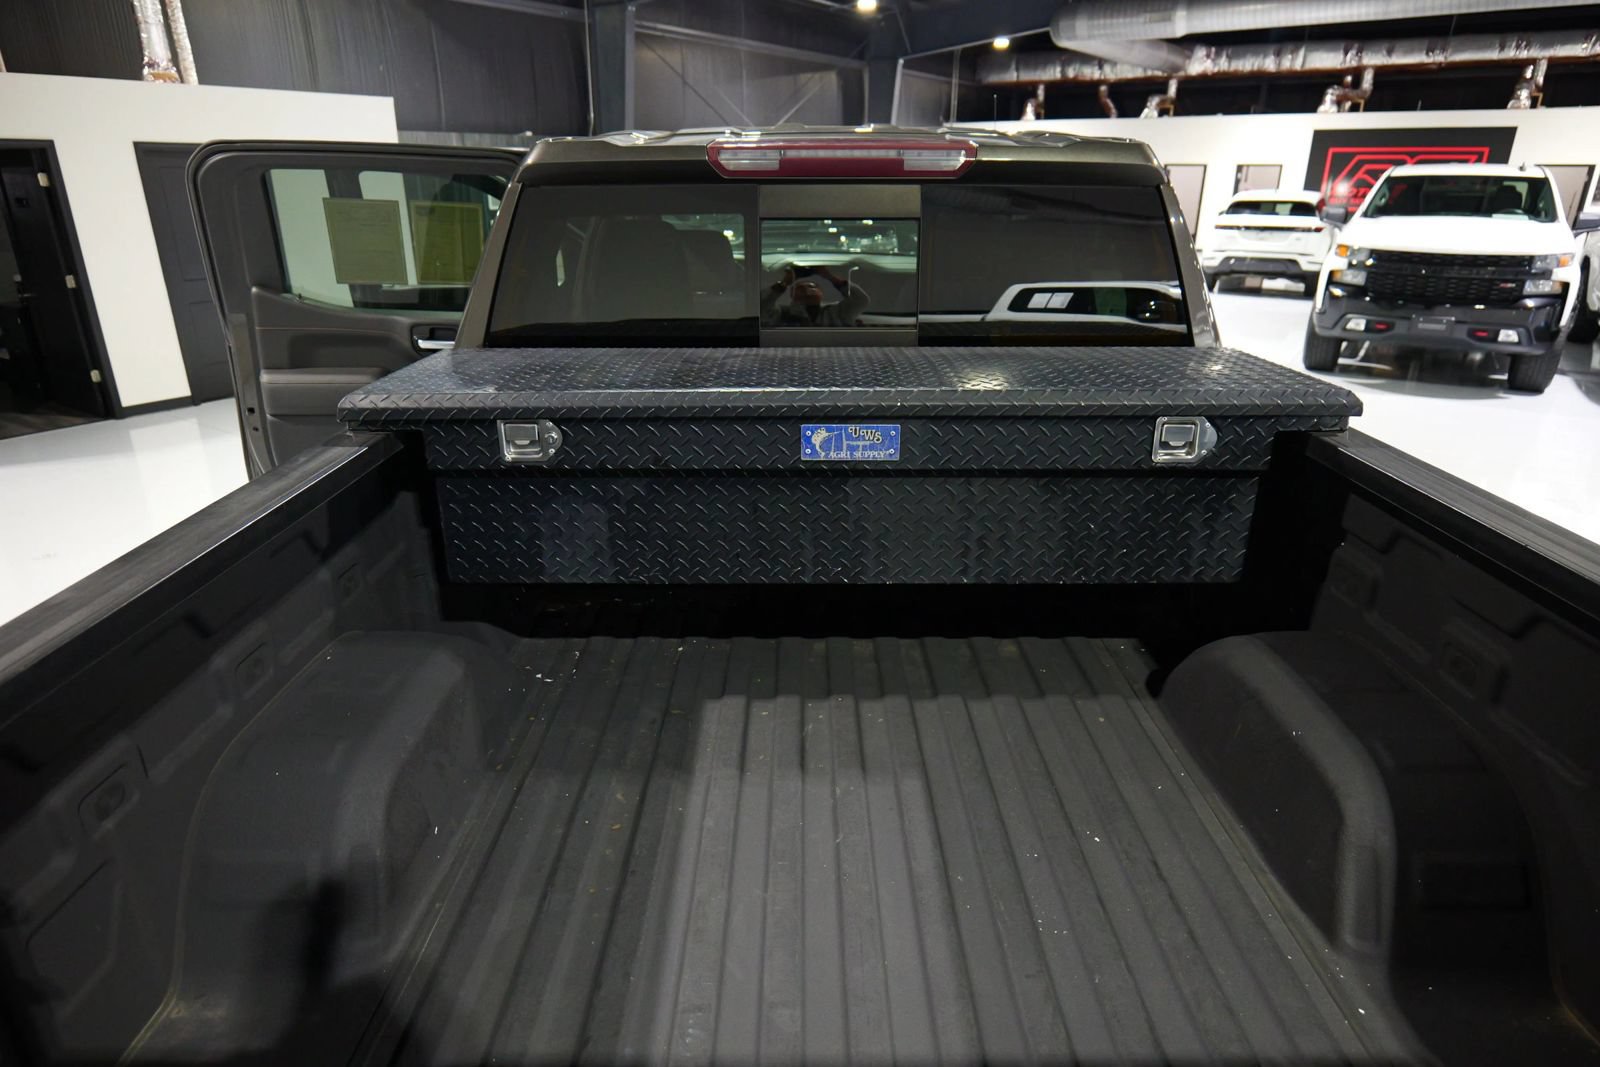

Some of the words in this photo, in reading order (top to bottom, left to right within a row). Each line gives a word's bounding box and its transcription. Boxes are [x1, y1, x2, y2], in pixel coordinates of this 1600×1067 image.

[848, 426, 882, 443] UWS
[828, 451, 850, 459] AGRI
[853, 451, 885, 459] SUPPLY
